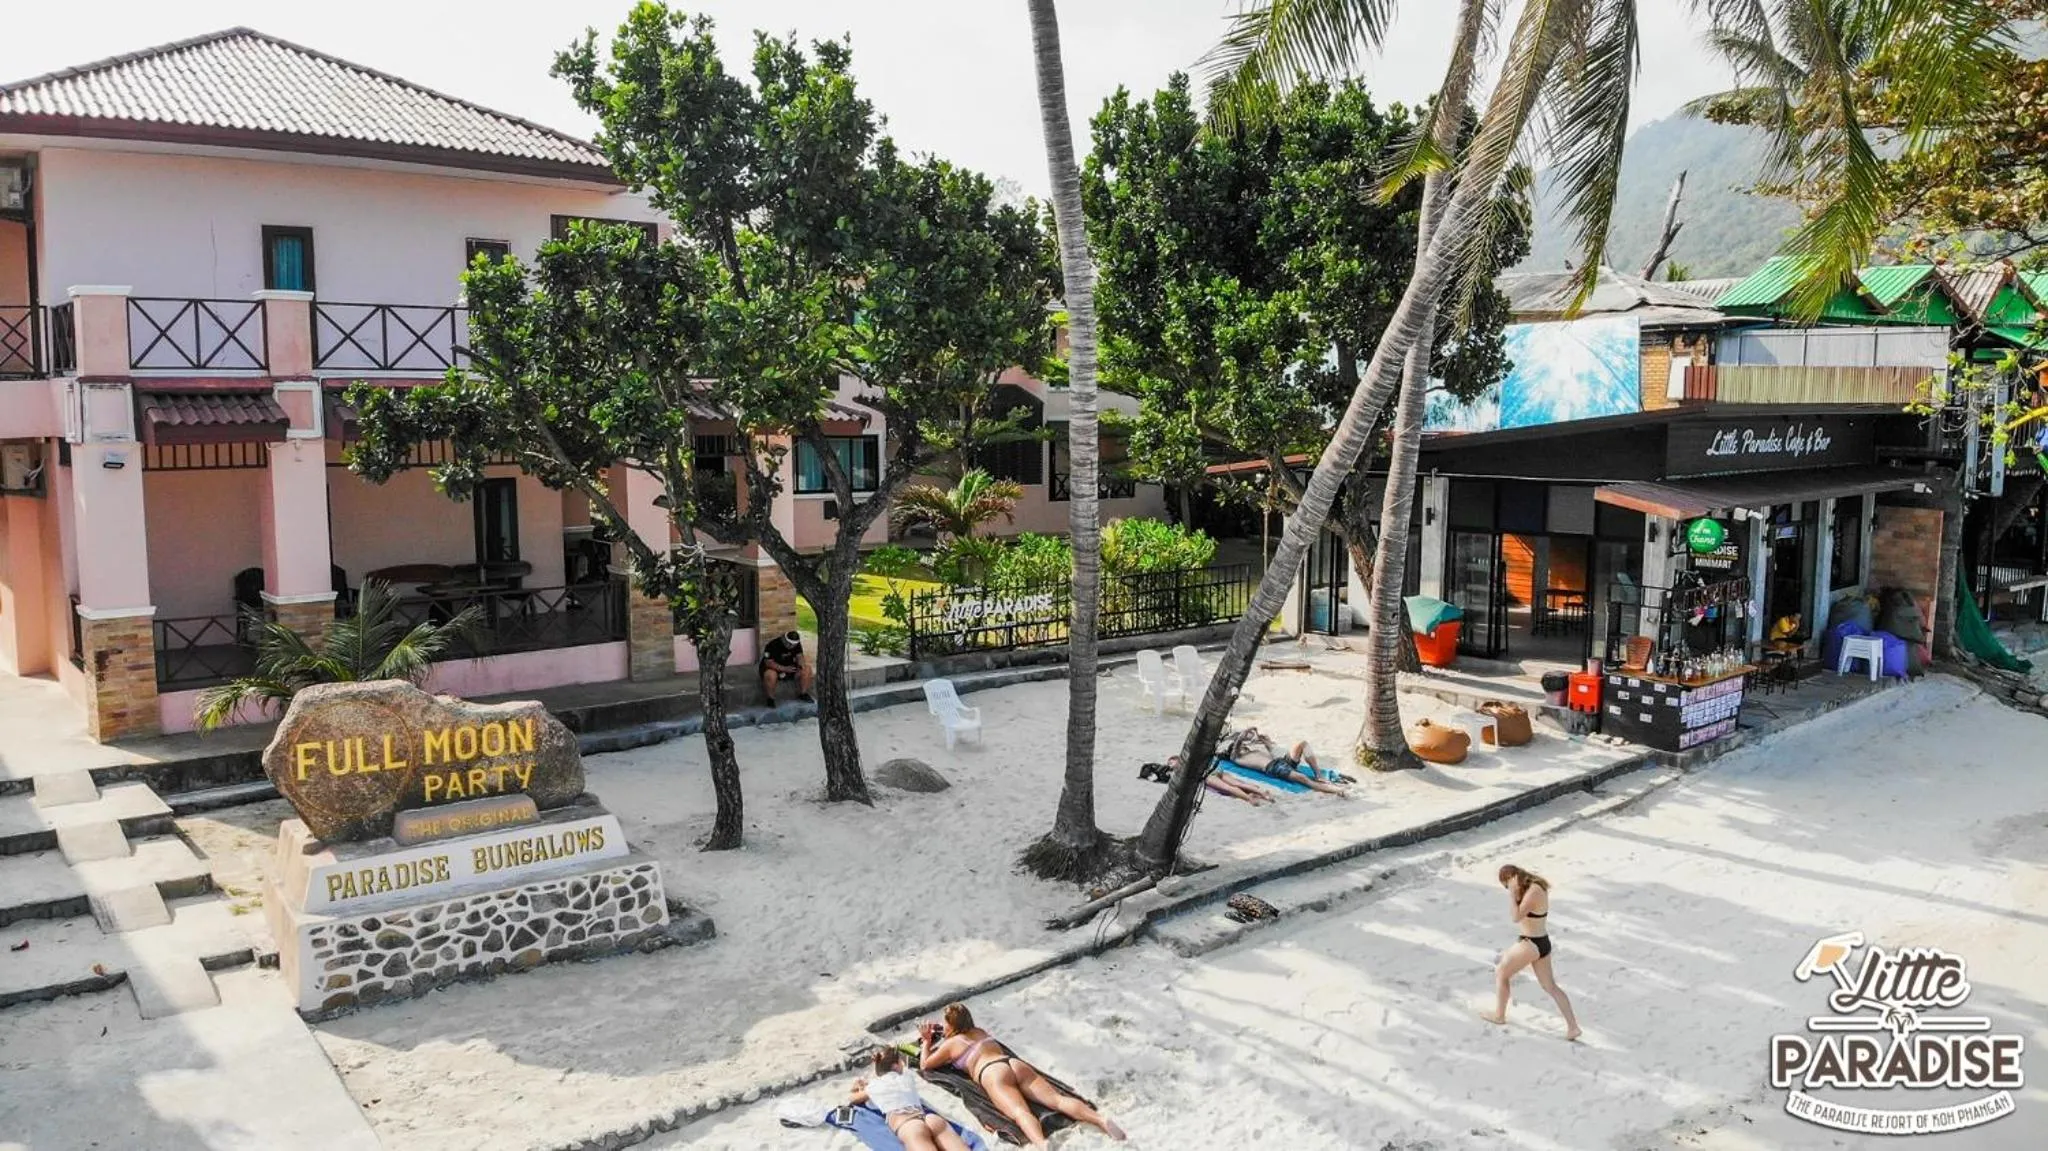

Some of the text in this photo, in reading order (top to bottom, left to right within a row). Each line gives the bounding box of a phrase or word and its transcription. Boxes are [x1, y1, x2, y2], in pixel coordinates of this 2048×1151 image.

[1706, 429, 1738, 456] Little
[1742, 428, 1783, 454] Paradise
[1785, 423, 1805, 457] Cafe
[1814, 427, 1832, 452] Bar
[1695, 557, 1733, 569] MINIMART
[984, 592, 1054, 617] PARADISE
[295, 718, 536, 781] FULL MOON
[424, 762, 537, 802] PARTY
[407, 806, 533, 837] THE ORIGINAL
[326, 826, 605, 902] PARADISE BUNGALOWS
